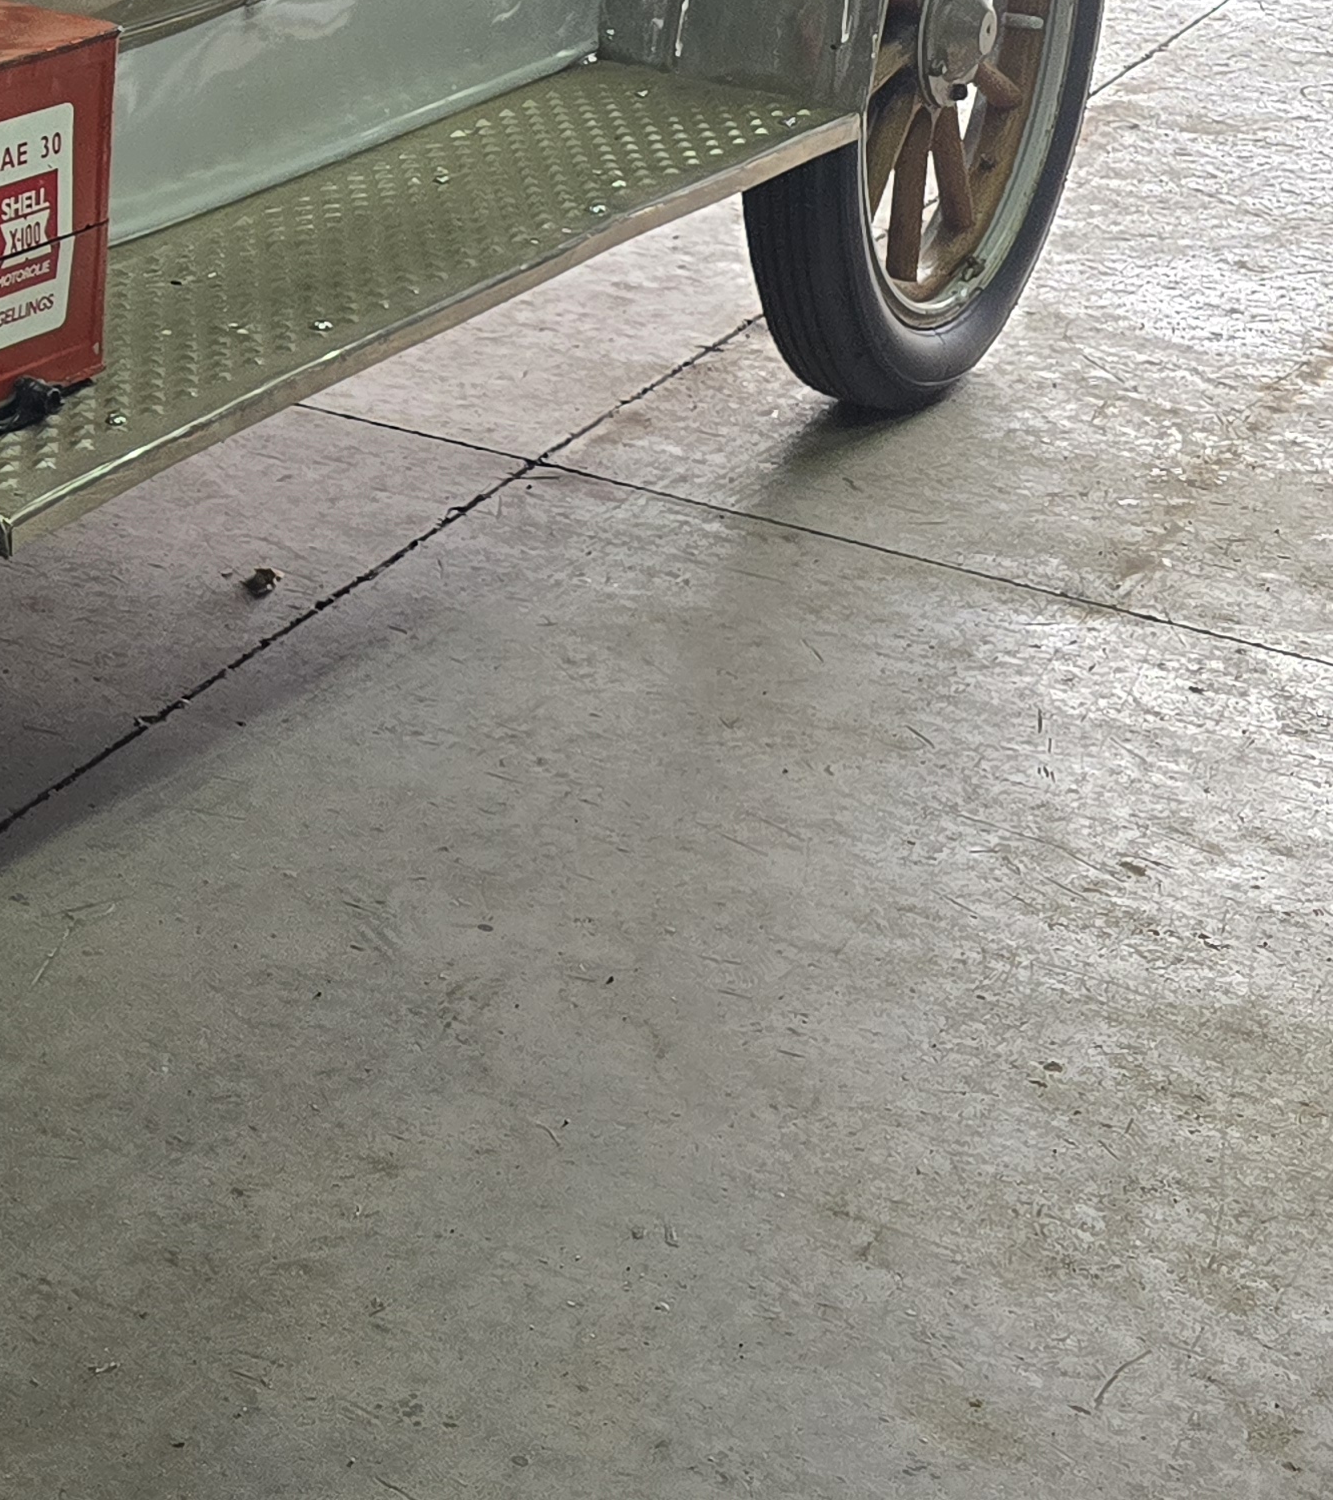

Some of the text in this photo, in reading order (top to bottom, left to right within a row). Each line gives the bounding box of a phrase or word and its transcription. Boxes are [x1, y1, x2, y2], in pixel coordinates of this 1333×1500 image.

[41, 132, 62, 159] 30
[1, 187, 50, 220] SHELL
[9, 221, 41, 254] X-100
